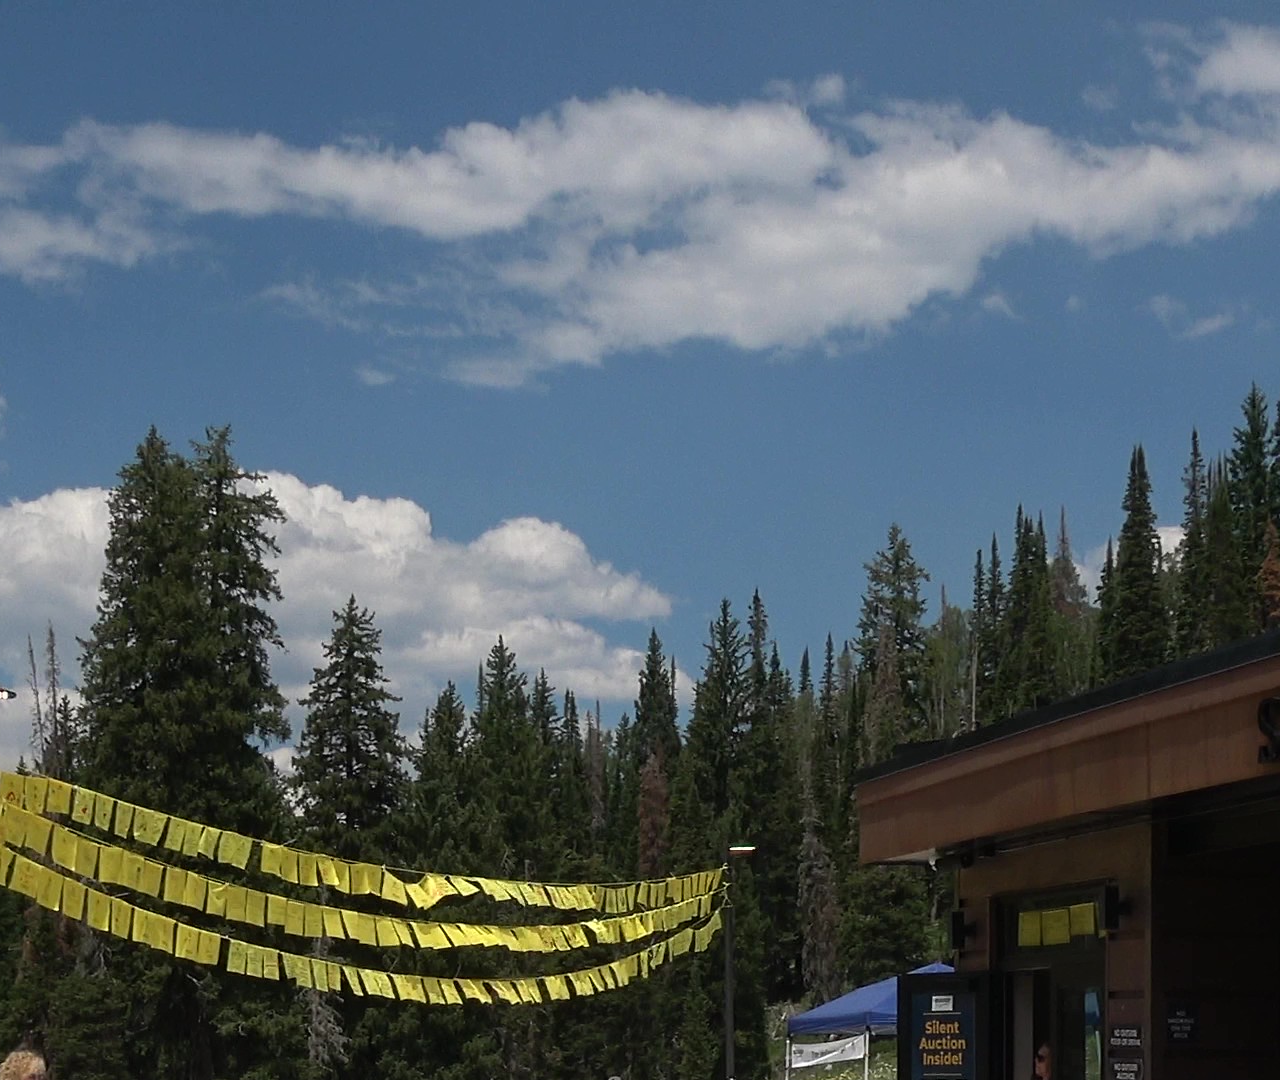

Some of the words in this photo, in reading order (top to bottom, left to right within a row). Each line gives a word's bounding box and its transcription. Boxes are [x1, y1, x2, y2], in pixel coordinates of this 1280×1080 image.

[924, 1020, 960, 1034] Silent
[919, 1036, 967, 1050] Auction
[923, 1051, 963, 1066] Inside!
